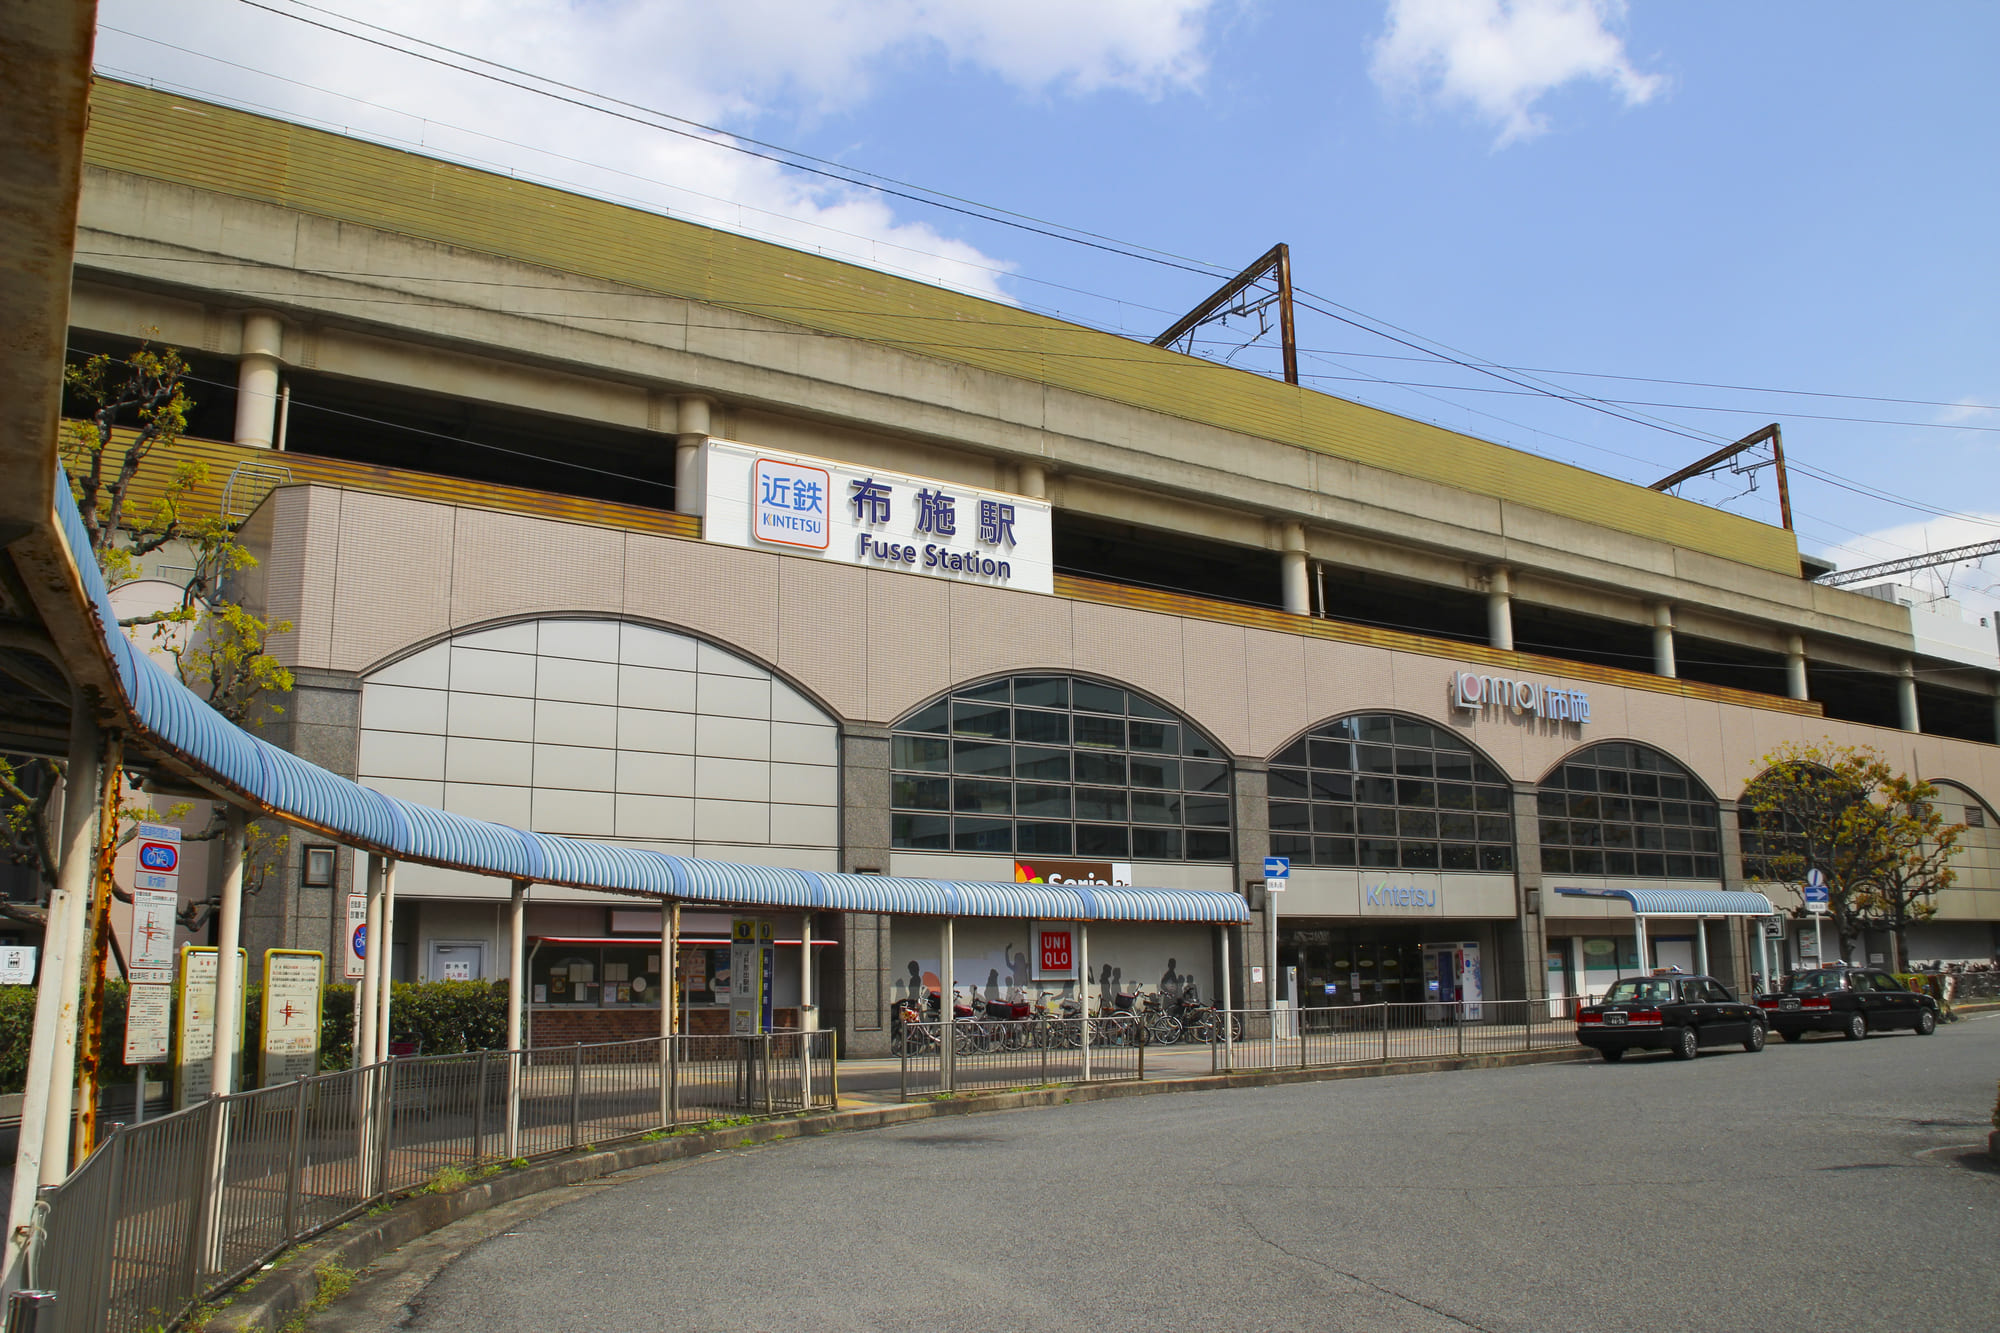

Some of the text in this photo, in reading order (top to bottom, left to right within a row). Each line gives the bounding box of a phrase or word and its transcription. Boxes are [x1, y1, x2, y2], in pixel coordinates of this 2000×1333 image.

[761, 474, 823, 514] 近鉄
[763, 513, 822, 534] KINTETSU
[851, 478, 1017, 547] 布施駅
[860, 533, 1012, 579] Fuse Station
[1366, 880, 1437, 907] Kintetsu
[1044, 936, 1066, 949] UNI
[1045, 952, 1068, 967] QLO
